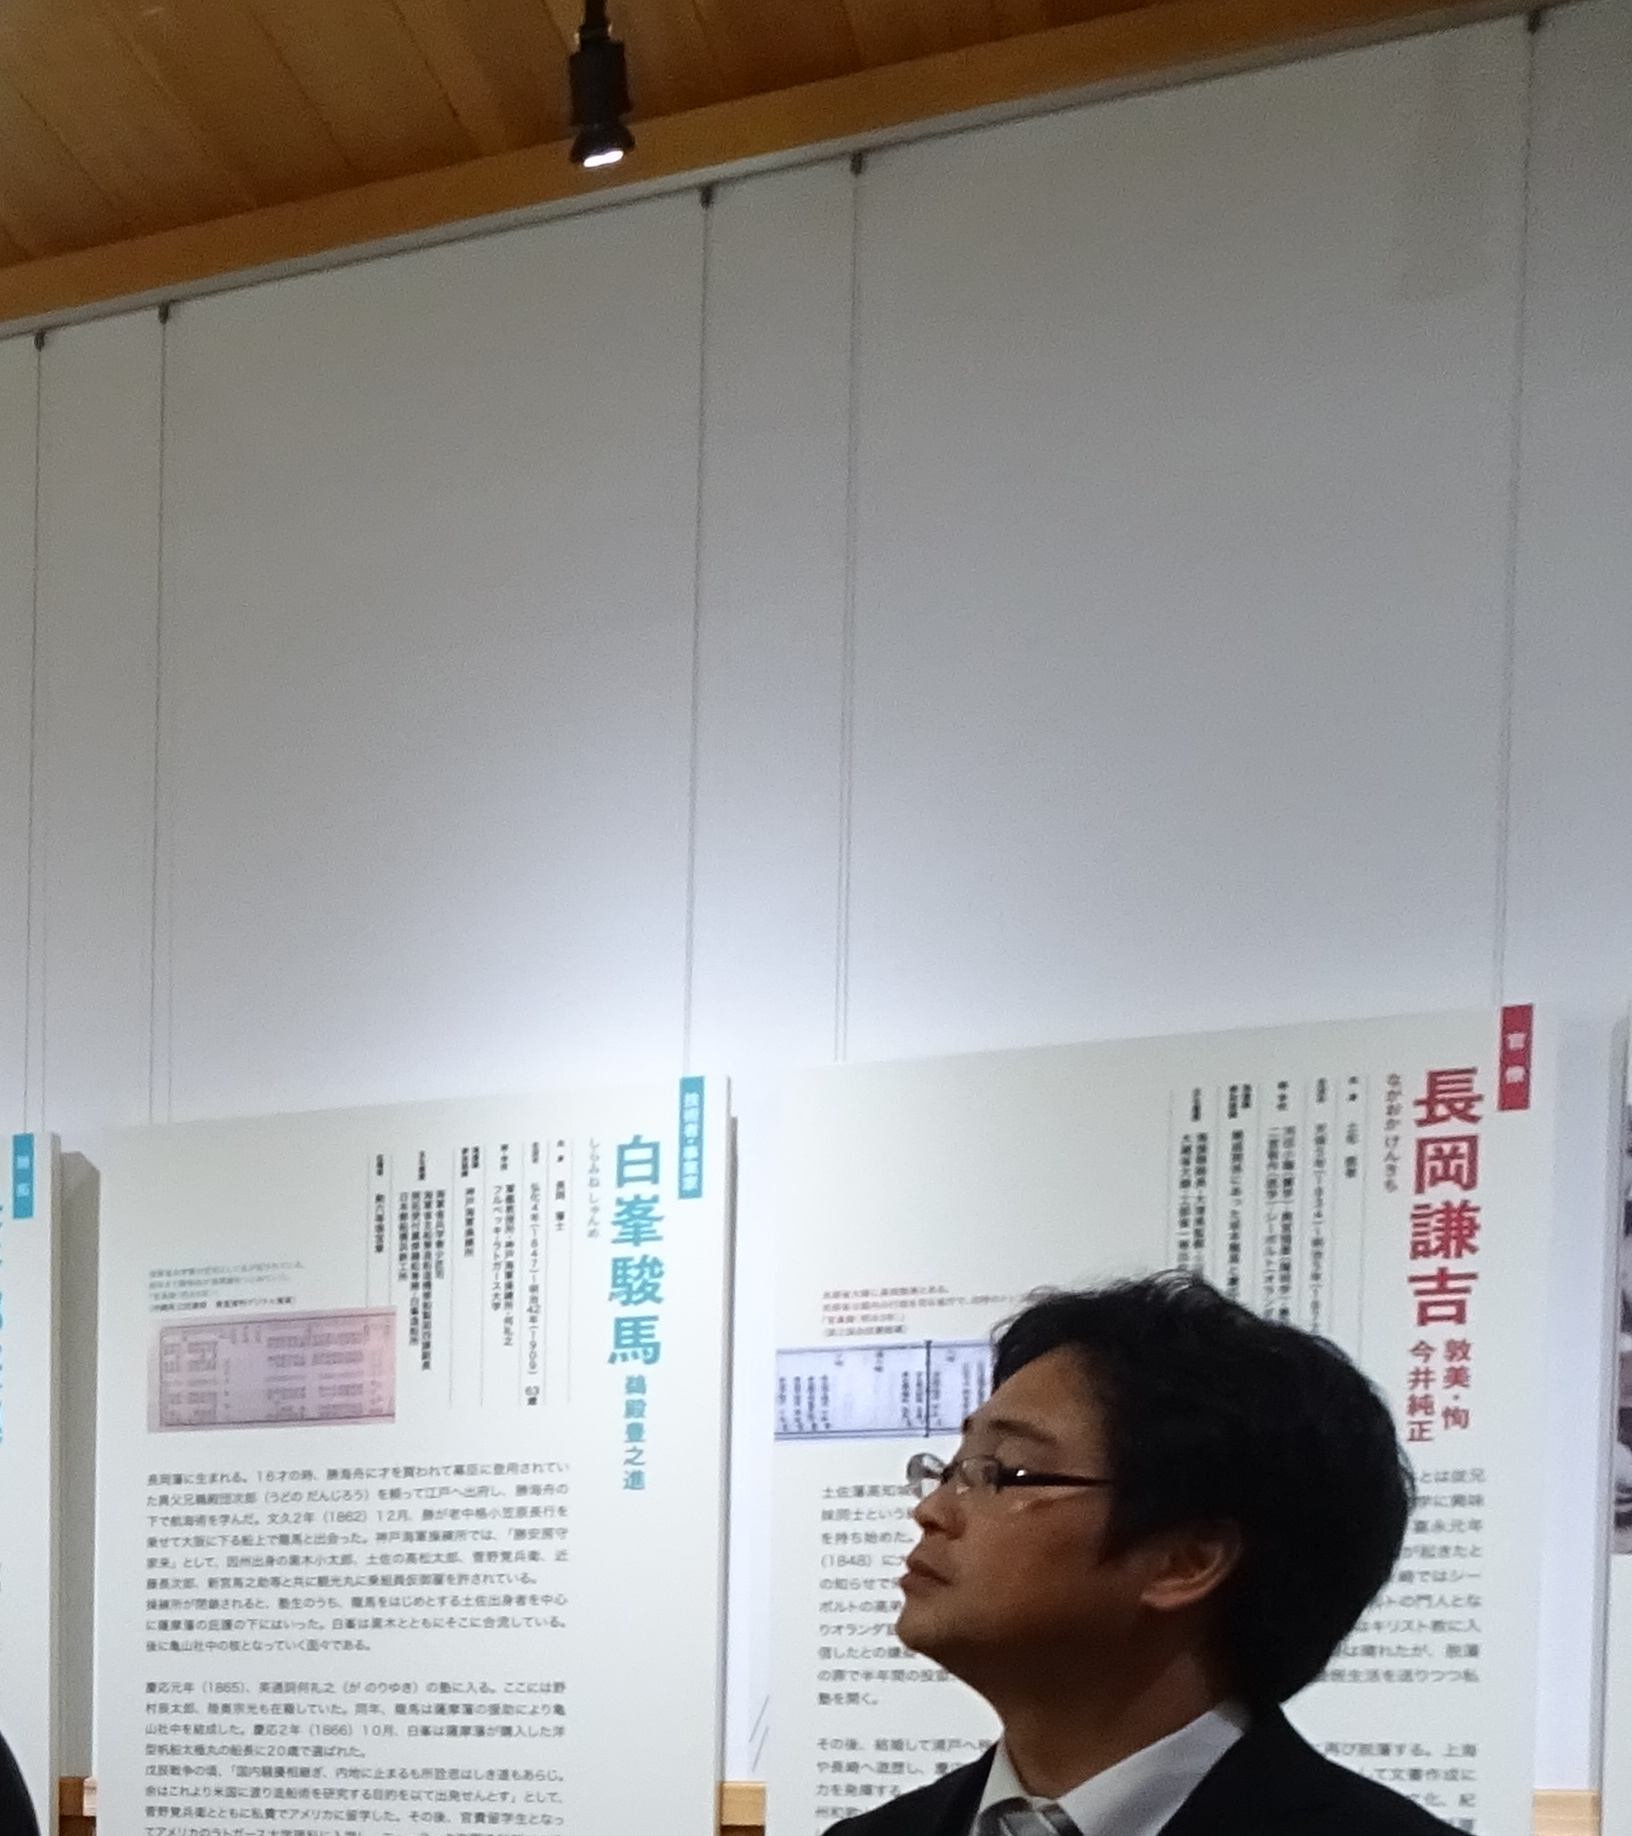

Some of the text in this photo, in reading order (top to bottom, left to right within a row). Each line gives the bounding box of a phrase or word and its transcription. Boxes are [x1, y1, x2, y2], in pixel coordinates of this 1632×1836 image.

[608, 1135, 665, 1365] 白峯駿馬
[1406, 1066, 1485, 1328] 長岡謙吉
[1405, 1339, 1437, 1443] 今井純正
[1440, 1338, 1472, 1431] 敦美・恂
